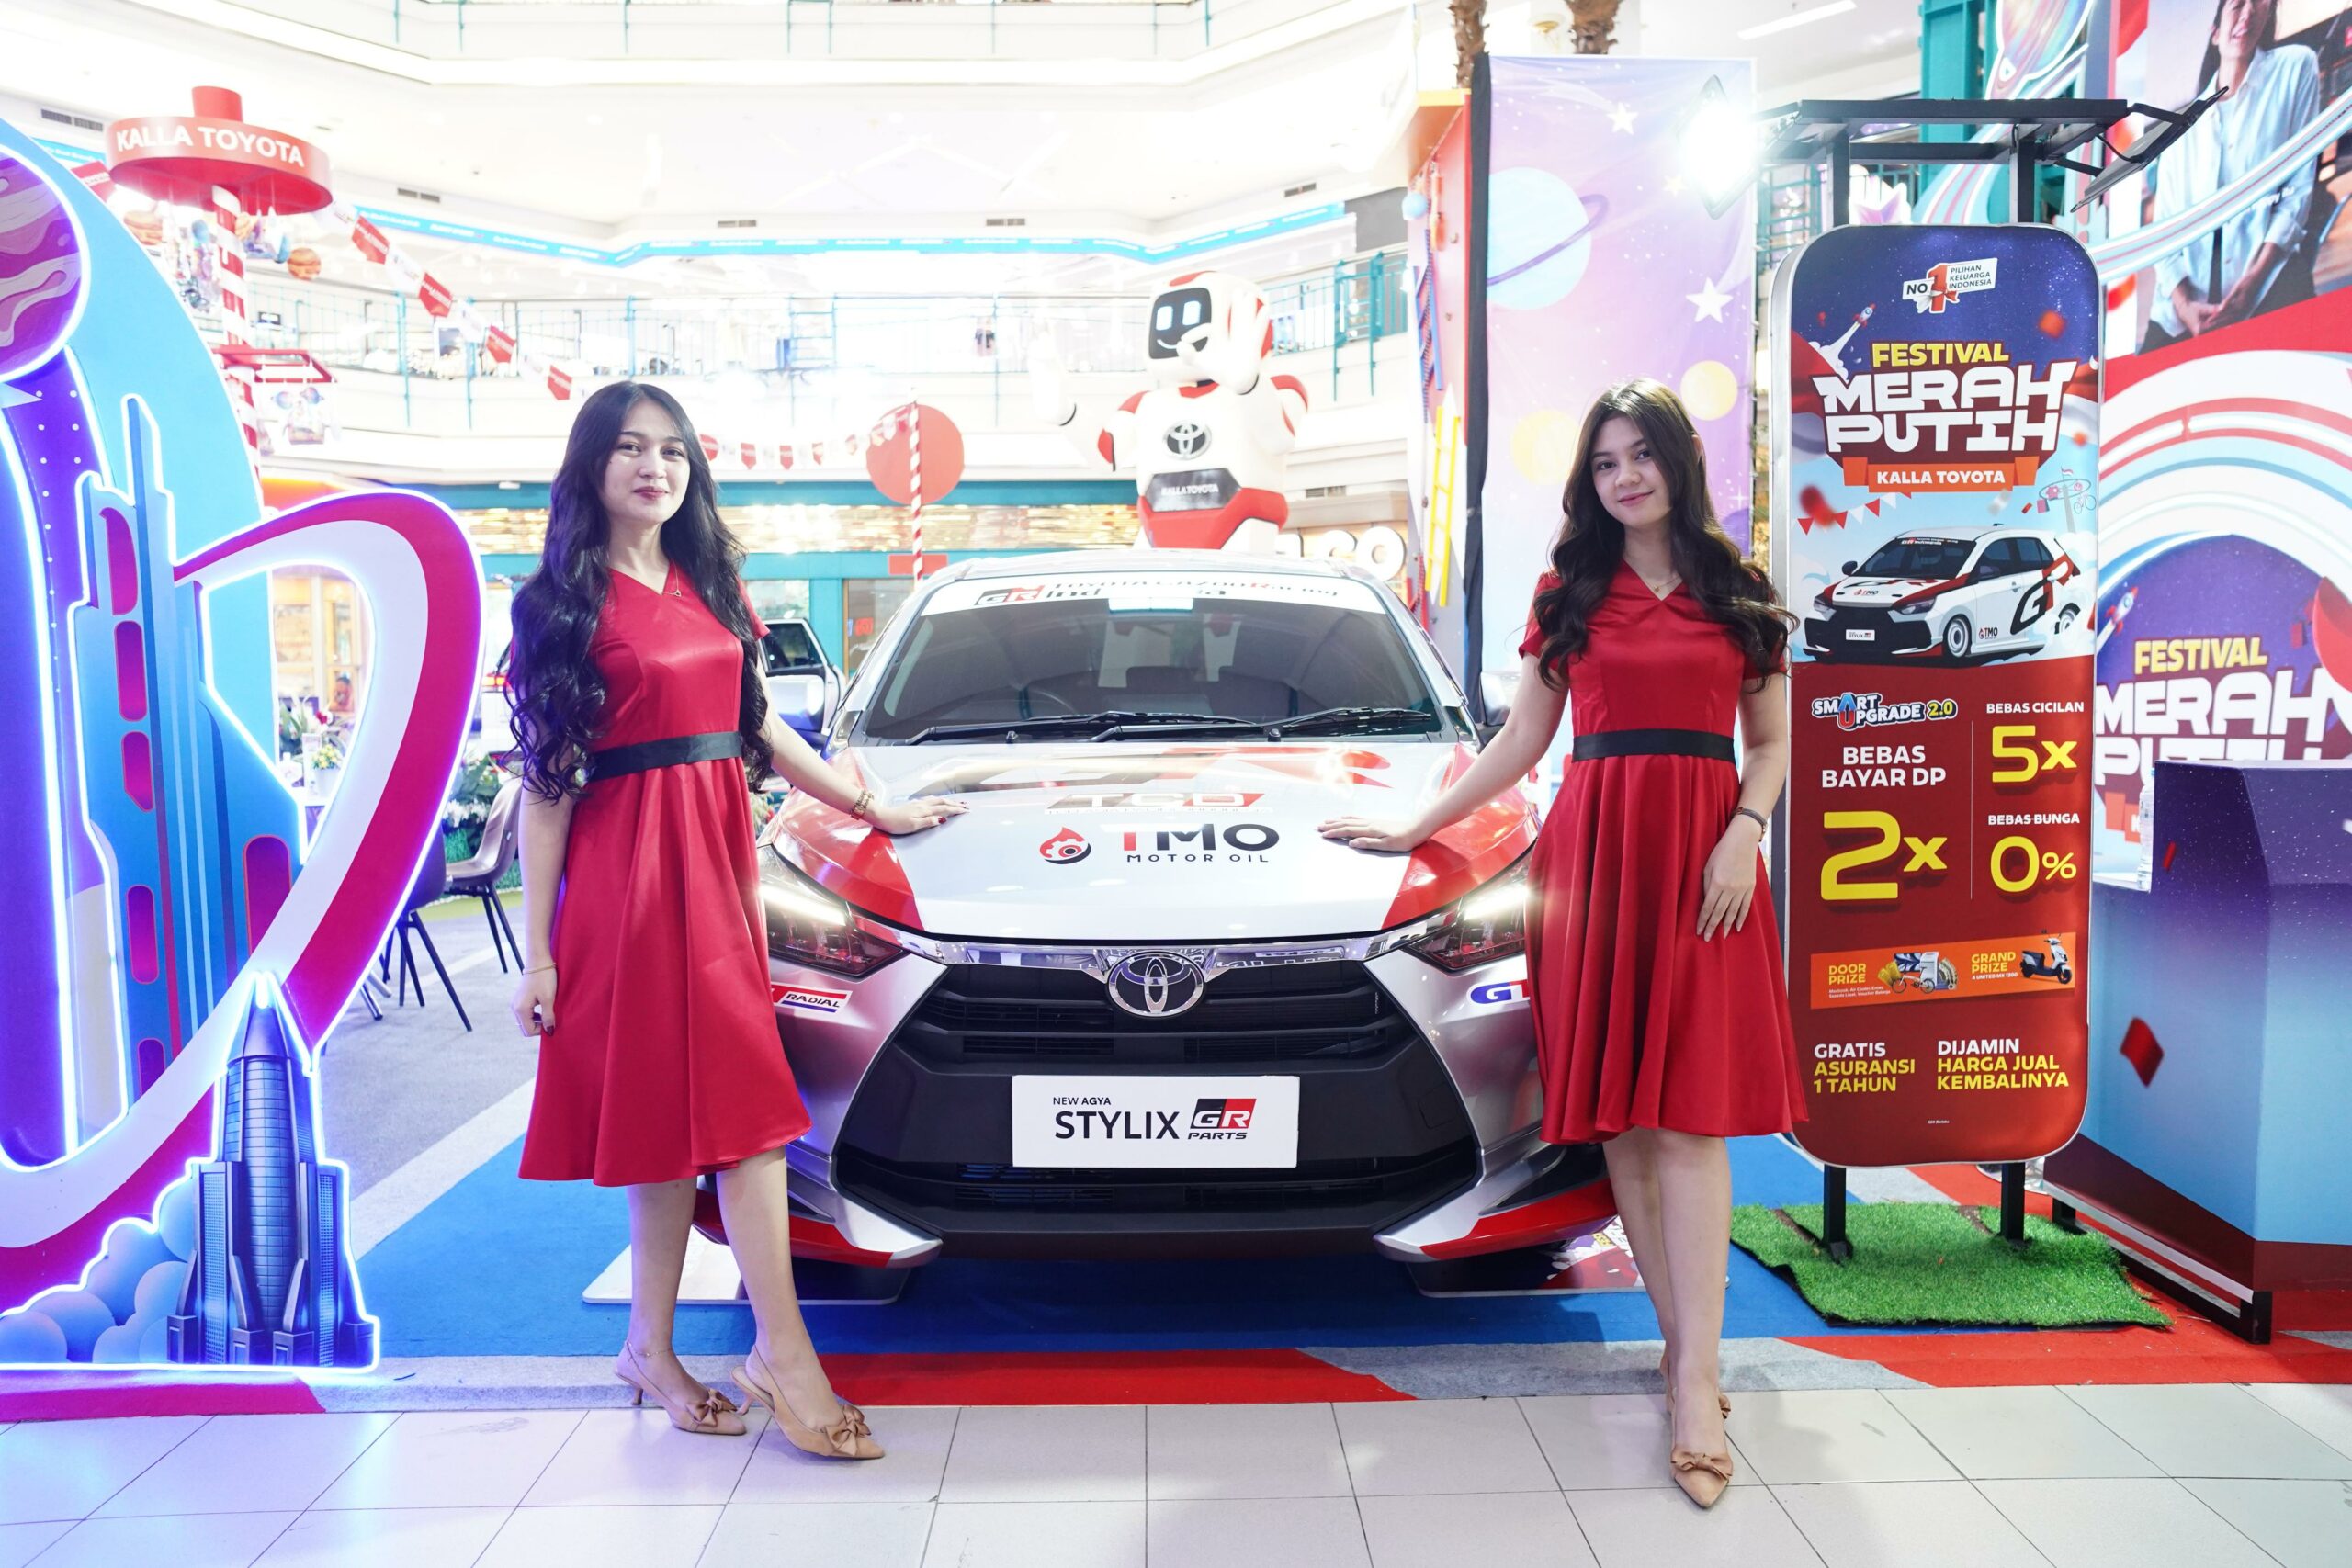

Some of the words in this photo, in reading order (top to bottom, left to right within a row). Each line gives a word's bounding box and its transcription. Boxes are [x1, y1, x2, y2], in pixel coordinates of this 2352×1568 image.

[116, 125, 193, 152] KALLA
[198, 127, 305, 167] TOYOTA
[1949, 271, 1991, 282] KELUARGA
[1950, 265, 1982, 274] PILIHAN
[1948, 278, 1992, 289] INDONESIA
[1871, 343, 2009, 367] FESTIVAL
[1812, 361, 2077, 412] MERAH
[1826, 409, 2059, 453] PUTIH
[1877, 471, 1933, 485] KALLA
[1936, 470, 2006, 484] TOYOTA
[1984, 627, 1998, 637] TMO
[2134, 637, 2267, 675] FESTIVAL
[1814, 694, 1877, 715] SMART
[1986, 704, 2030, 714] BEBAS
[2032, 702, 2085, 712] CICILAN
[2095, 667, 2331, 742] MERAH
[1838, 704, 1921, 728] UPGRADE
[1928, 701, 1953, 716] 2.0
[1843, 746, 1926, 765] BEBAS
[1822, 768, 1908, 788] BAYAR
[1912, 765, 1947, 786] DP
[1988, 815, 2031, 826] BEBAS
[2034, 813, 2080, 825] BUNGA
[1114, 823, 1280, 852] TMO
[1126, 854, 1214, 863] MOTOR
[1229, 854, 1269, 863] OIL
[1990, 836, 2077, 892] 0%
[1971, 952, 2017, 964] GRAND
[1828, 963, 1867, 976] DOOR
[1971, 962, 2008, 974] PRIZE
[1828, 974, 1867, 986] PRIZE
[786, 993, 841, 1008] RADIAL
[1814, 1042, 1886, 1059] GRATIS
[1937, 1038, 2020, 1055] DIJAMIN
[1814, 1058, 1916, 1077] ASURANSI
[1937, 1057, 2008, 1074] HARGA
[2011, 1055, 2060, 1071] JUAL
[1814, 1079, 1822, 1094] 1
[1826, 1077, 1896, 1094] TAHUN
[1936, 1072, 2070, 1091] KEMBALINYA
[1053, 1097, 1079, 1106] NEW
[1081, 1097, 1112, 1106] AGYA
[1055, 1111, 1180, 1140] STYLIX
[1192, 1110, 1250, 1128] GR
[1187, 1132, 1248, 1141] PARTS
